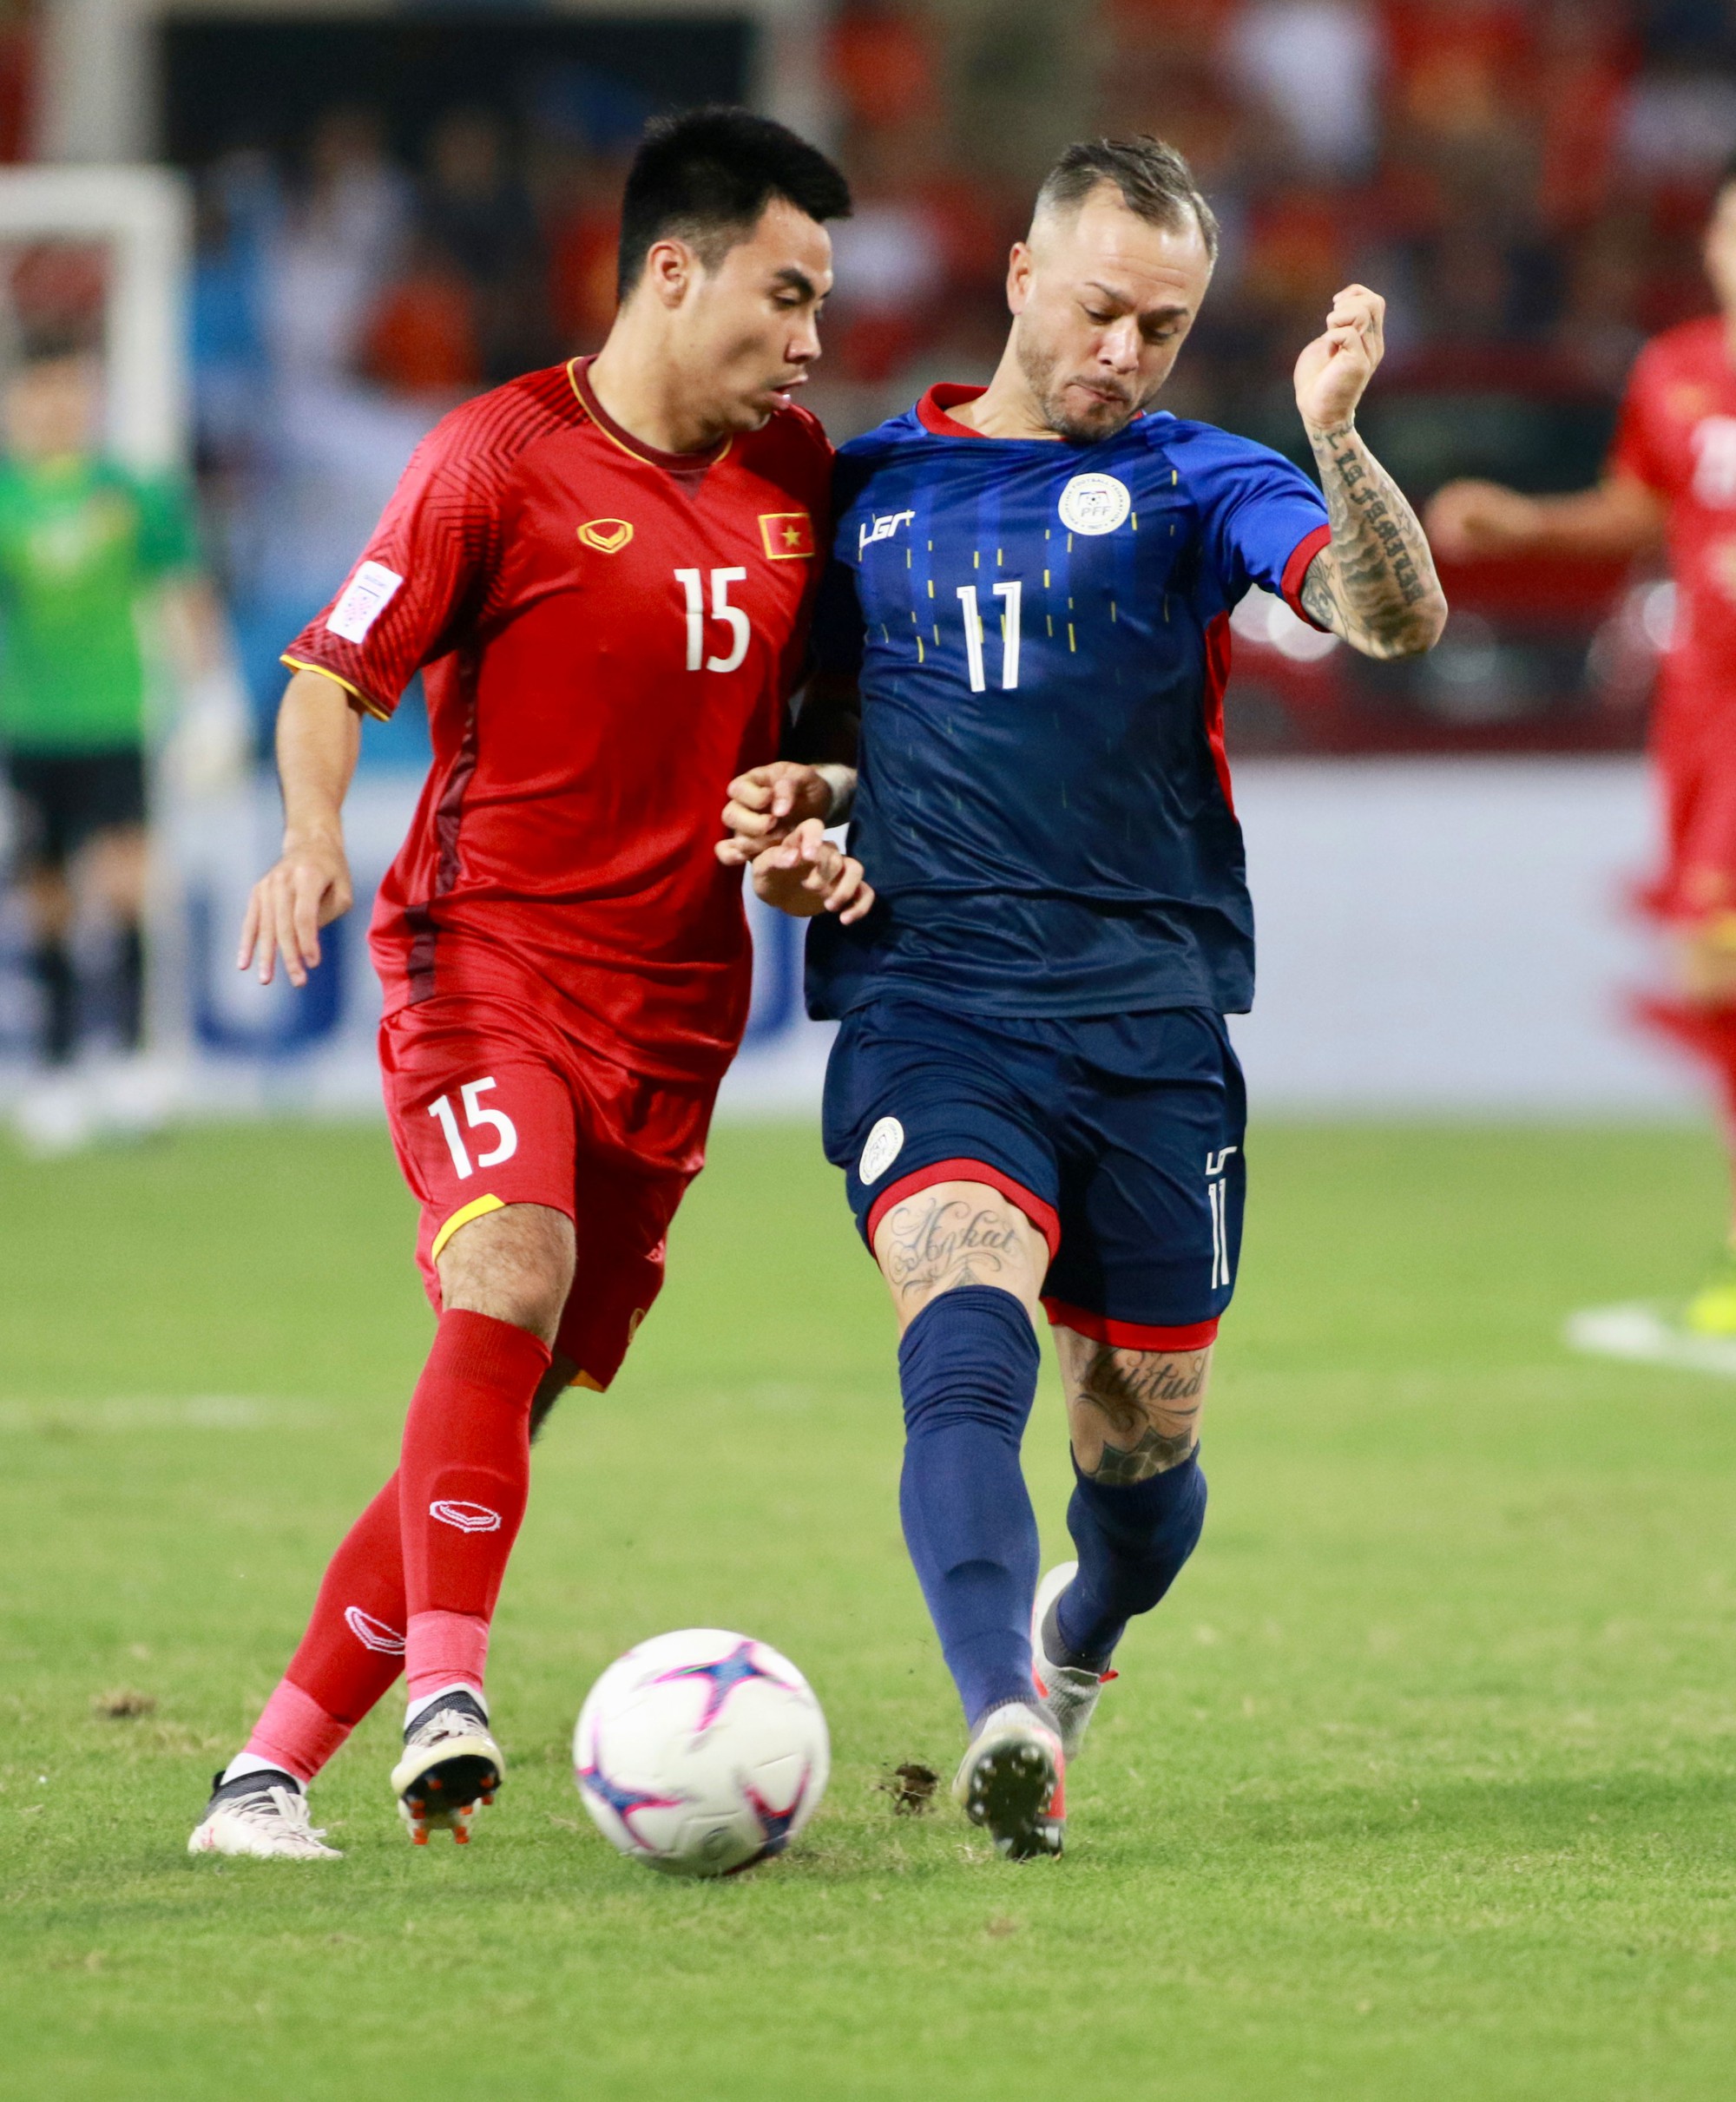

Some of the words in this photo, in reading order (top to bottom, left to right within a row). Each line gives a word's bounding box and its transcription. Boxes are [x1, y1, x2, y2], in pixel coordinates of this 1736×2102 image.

[1081, 505, 1112, 517] PFF
[674, 567, 752, 673] 15
[957, 581, 1022, 693] 11
[427, 1076, 518, 1180] 15
[1208, 1177, 1230, 1290] 11
